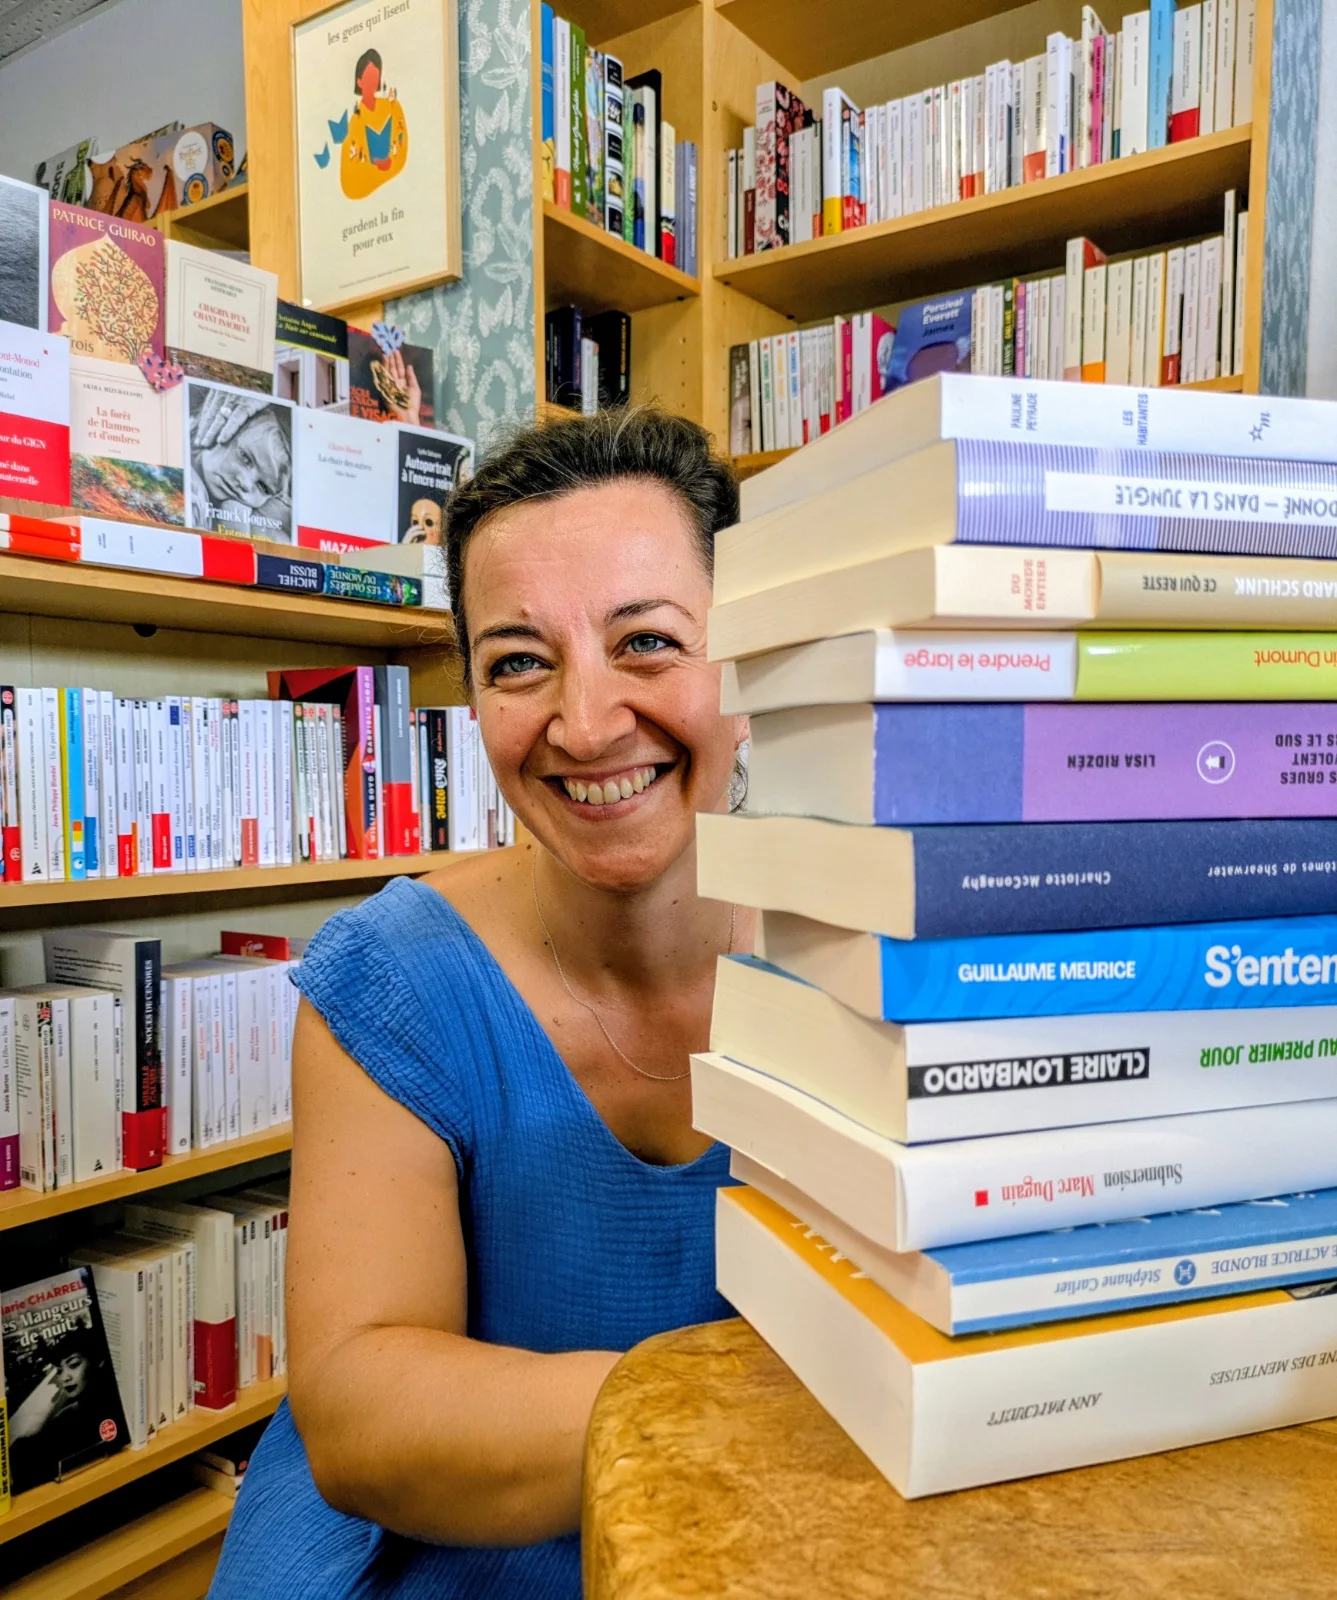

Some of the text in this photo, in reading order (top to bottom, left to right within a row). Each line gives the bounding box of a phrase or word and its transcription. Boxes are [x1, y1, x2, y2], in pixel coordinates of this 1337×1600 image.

[328, 1, 410, 45] les gens qui lisent
[689, 191, 696, 202] LA
[53, 208, 156, 247] PATRICE GUIRAO
[342, 208, 405, 242] gardent la fin
[352, 231, 394, 256] pour eux
[199, 303, 247, 323] CHAGRIN D'UN
[923, 297, 965, 315] Percival
[193, 311, 250, 334] CHANT INACHEVÉ
[923, 308, 959, 325] Everett
[922, 324, 954, 338] James
[63, 335, 94, 353] rois
[97, 407, 131, 421] La forêt
[1010, 392, 1023, 429] PAULINE
[1026, 392, 1038, 431] PEYRADE
[1123, 409, 1133, 427] LES
[1137, 393, 1149, 446] HABITANTES
[88, 419, 140, 434] de flammes
[23, 438, 47, 449] GIGN
[88, 431, 140, 445] et d'ombres
[11, 461, 30, 473] dans
[318, 454, 327, 462] La
[354, 462, 372, 472] autres
[405, 454, 452, 476] Autoportrait
[402, 469, 453, 490] à l'encre noire
[1115, 484, 1183, 508] JUNGLE
[1189, 491, 1208, 511] LA
[1214, 492, 1259, 513] DANS
[205, 502, 282, 530] Franck Bouysse
[290, 564, 318, 578] BUSSI
[331, 570, 376, 584] DU MONDE
[278, 574, 317, 589] MICHEL
[330, 582, 381, 595] LES OMBRES
[1011, 574, 1020, 594] DU
[1024, 558, 1034, 611] MONDE
[1036, 559, 1046, 611] ENTIER
[1143, 575, 1176, 592] RESTE
[1179, 575, 1201, 593] QUI
[1203, 577, 1217, 592] CE
[1234, 578, 1300, 597] SCHLINK
[904, 648, 1051, 672] Prendre le large
[1254, 649, 1321, 668] Dumont
[1275, 734, 1324, 748] LE SUD
[1067, 754, 1156, 772] LISA RIDZÉN
[1280, 770, 1325, 785] GRUES
[1207, 864, 1278, 878] Shearwater
[1282, 863, 1297, 874] de
[962, 871, 1111, 890] Charlotte McConaghy
[958, 960, 1137, 983] GUILLAUME MEURICE
[145, 959, 153, 1044] NOCES DE CENDRES
[1200, 1044, 1244, 1068] JOUR
[1249, 1041, 1314, 1064] PREMIER
[924, 1050, 1147, 1094] CLAIRE LOMBARDO
[142, 1065, 150, 1106] MIREILLE
[149, 1066, 157, 1102] CALMEL
[1001, 1163, 1183, 1207] Submersion Marc Dugain
[1211, 1256, 1268, 1275] BLONDE
[1271, 1246, 1329, 1266] ACTRICE
[1054, 1276, 1099, 1294] Carlier
[1101, 1268, 1162, 1288] Stéphane
[28, 1281, 85, 1305] CHARREL
[20, 1296, 92, 1328] Mangeurs
[20, 1319, 73, 1347] de nuit
[1209, 1359, 1290, 1386] MENTEUSES
[1291, 1355, 1318, 1371] DES
[1068, 1392, 1103, 1410] ANN
[3, 1479, 8, 1494] DE
